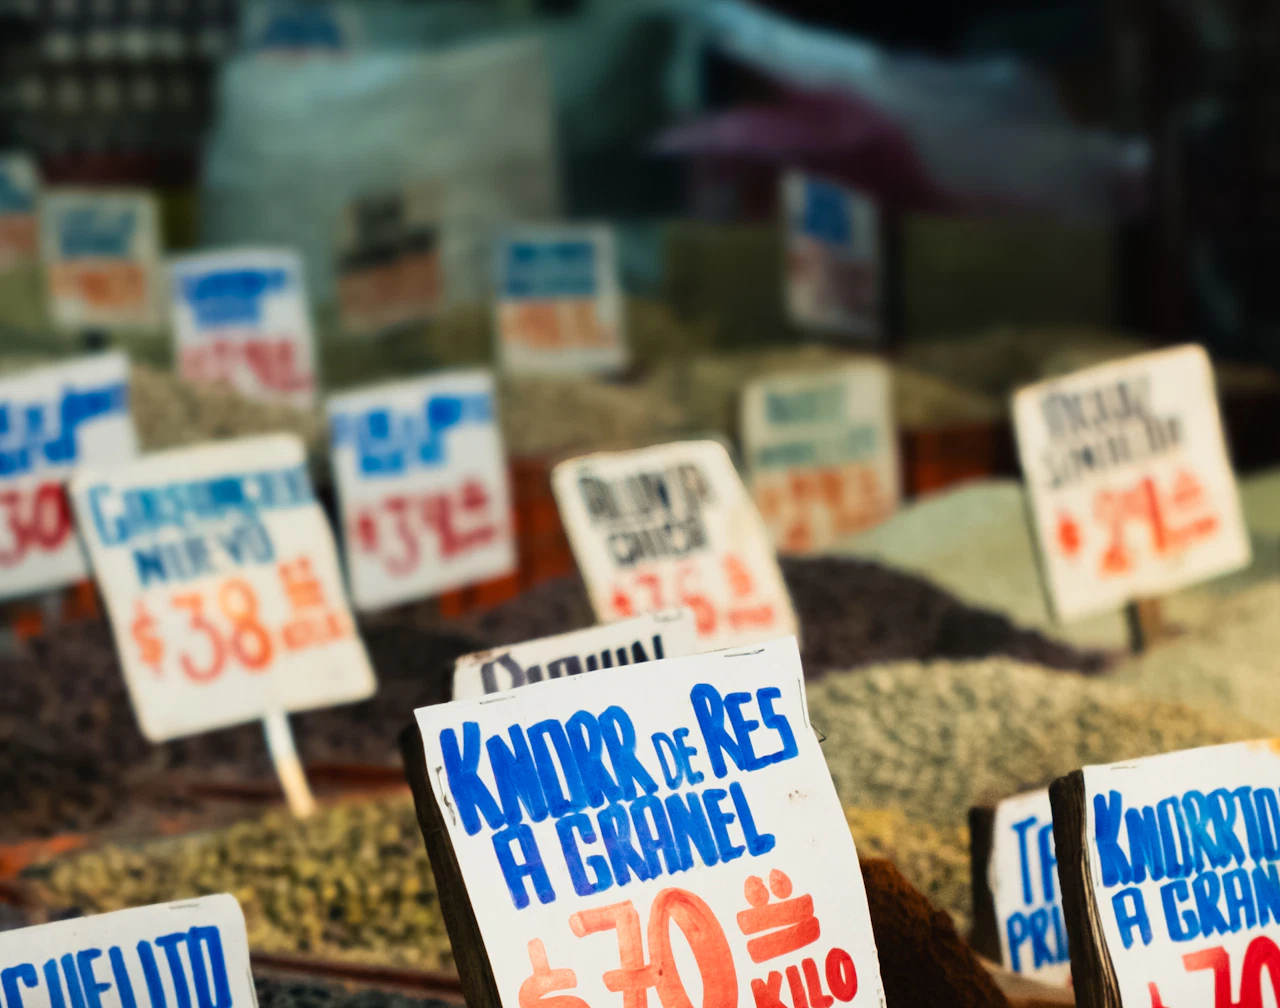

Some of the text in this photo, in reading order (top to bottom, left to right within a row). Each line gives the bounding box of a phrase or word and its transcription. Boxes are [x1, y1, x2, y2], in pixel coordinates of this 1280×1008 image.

[131, 577, 274, 684] $38
[440, 683, 798, 836] KNORR DE RES
[491, 781, 776, 910] A GRANEL
[1111, 887, 1154, 950] A
